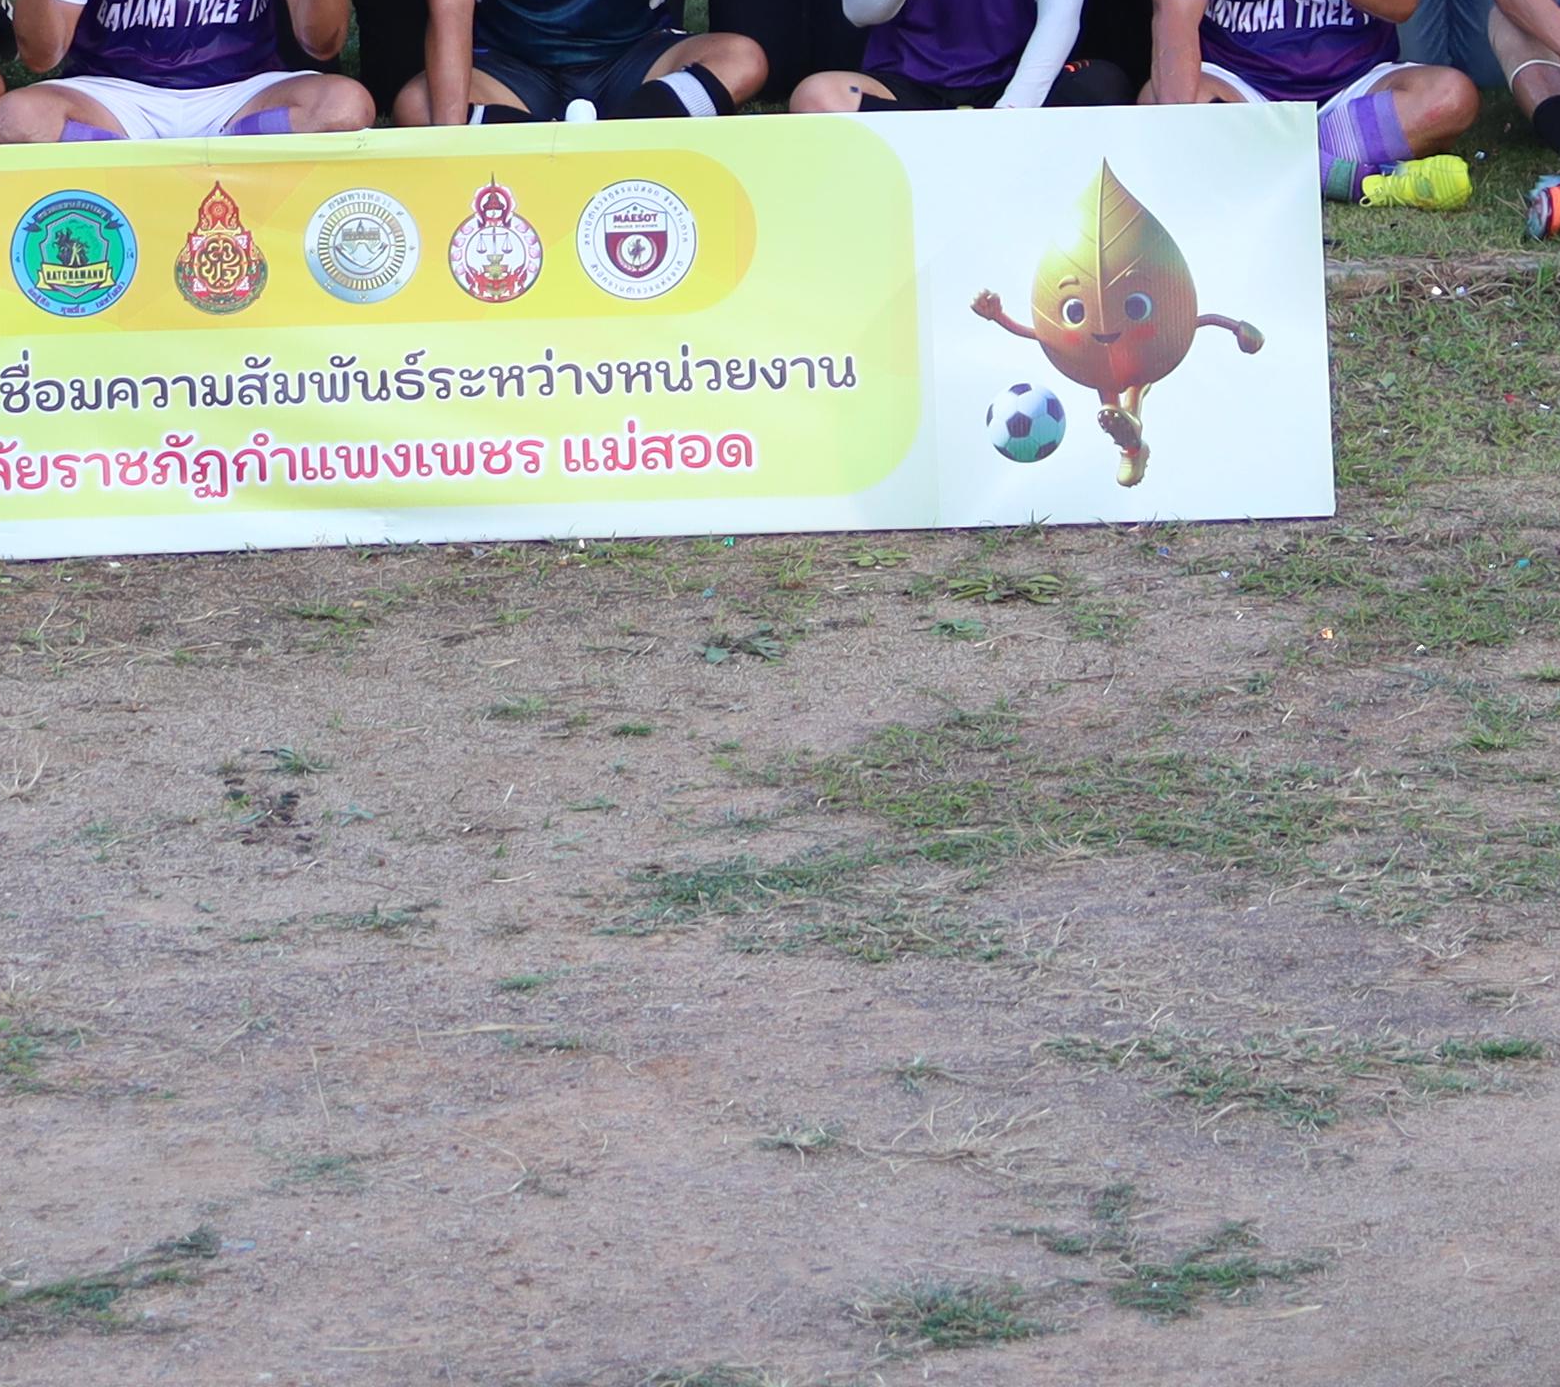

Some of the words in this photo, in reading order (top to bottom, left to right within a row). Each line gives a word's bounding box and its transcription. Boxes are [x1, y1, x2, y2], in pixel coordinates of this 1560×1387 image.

[613, 213, 658, 224] MAESOT
[563, 420, 755, 474] แม่สอด
